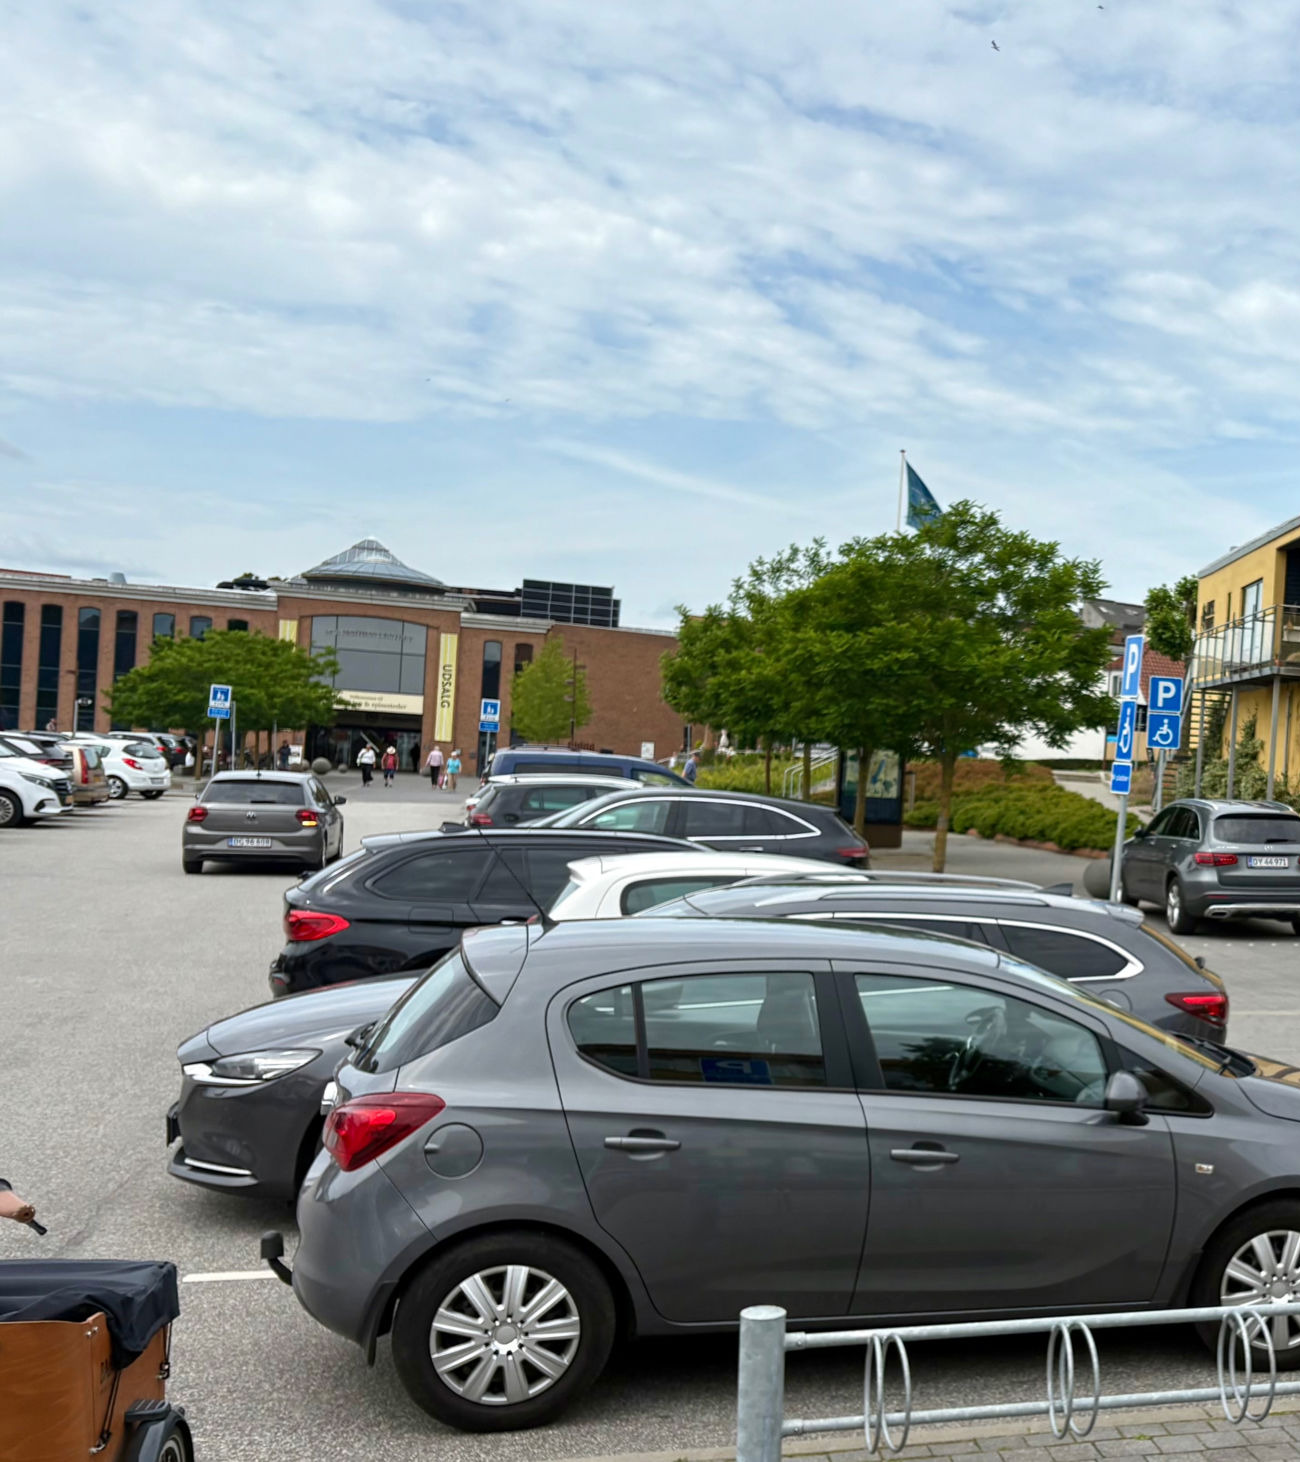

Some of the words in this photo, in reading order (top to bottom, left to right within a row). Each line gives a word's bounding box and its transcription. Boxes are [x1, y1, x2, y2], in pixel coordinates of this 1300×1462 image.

[441, 664, 453, 709] UDSALG
[1125, 643, 1139, 690] P
[1157, 680, 1176, 708] P
